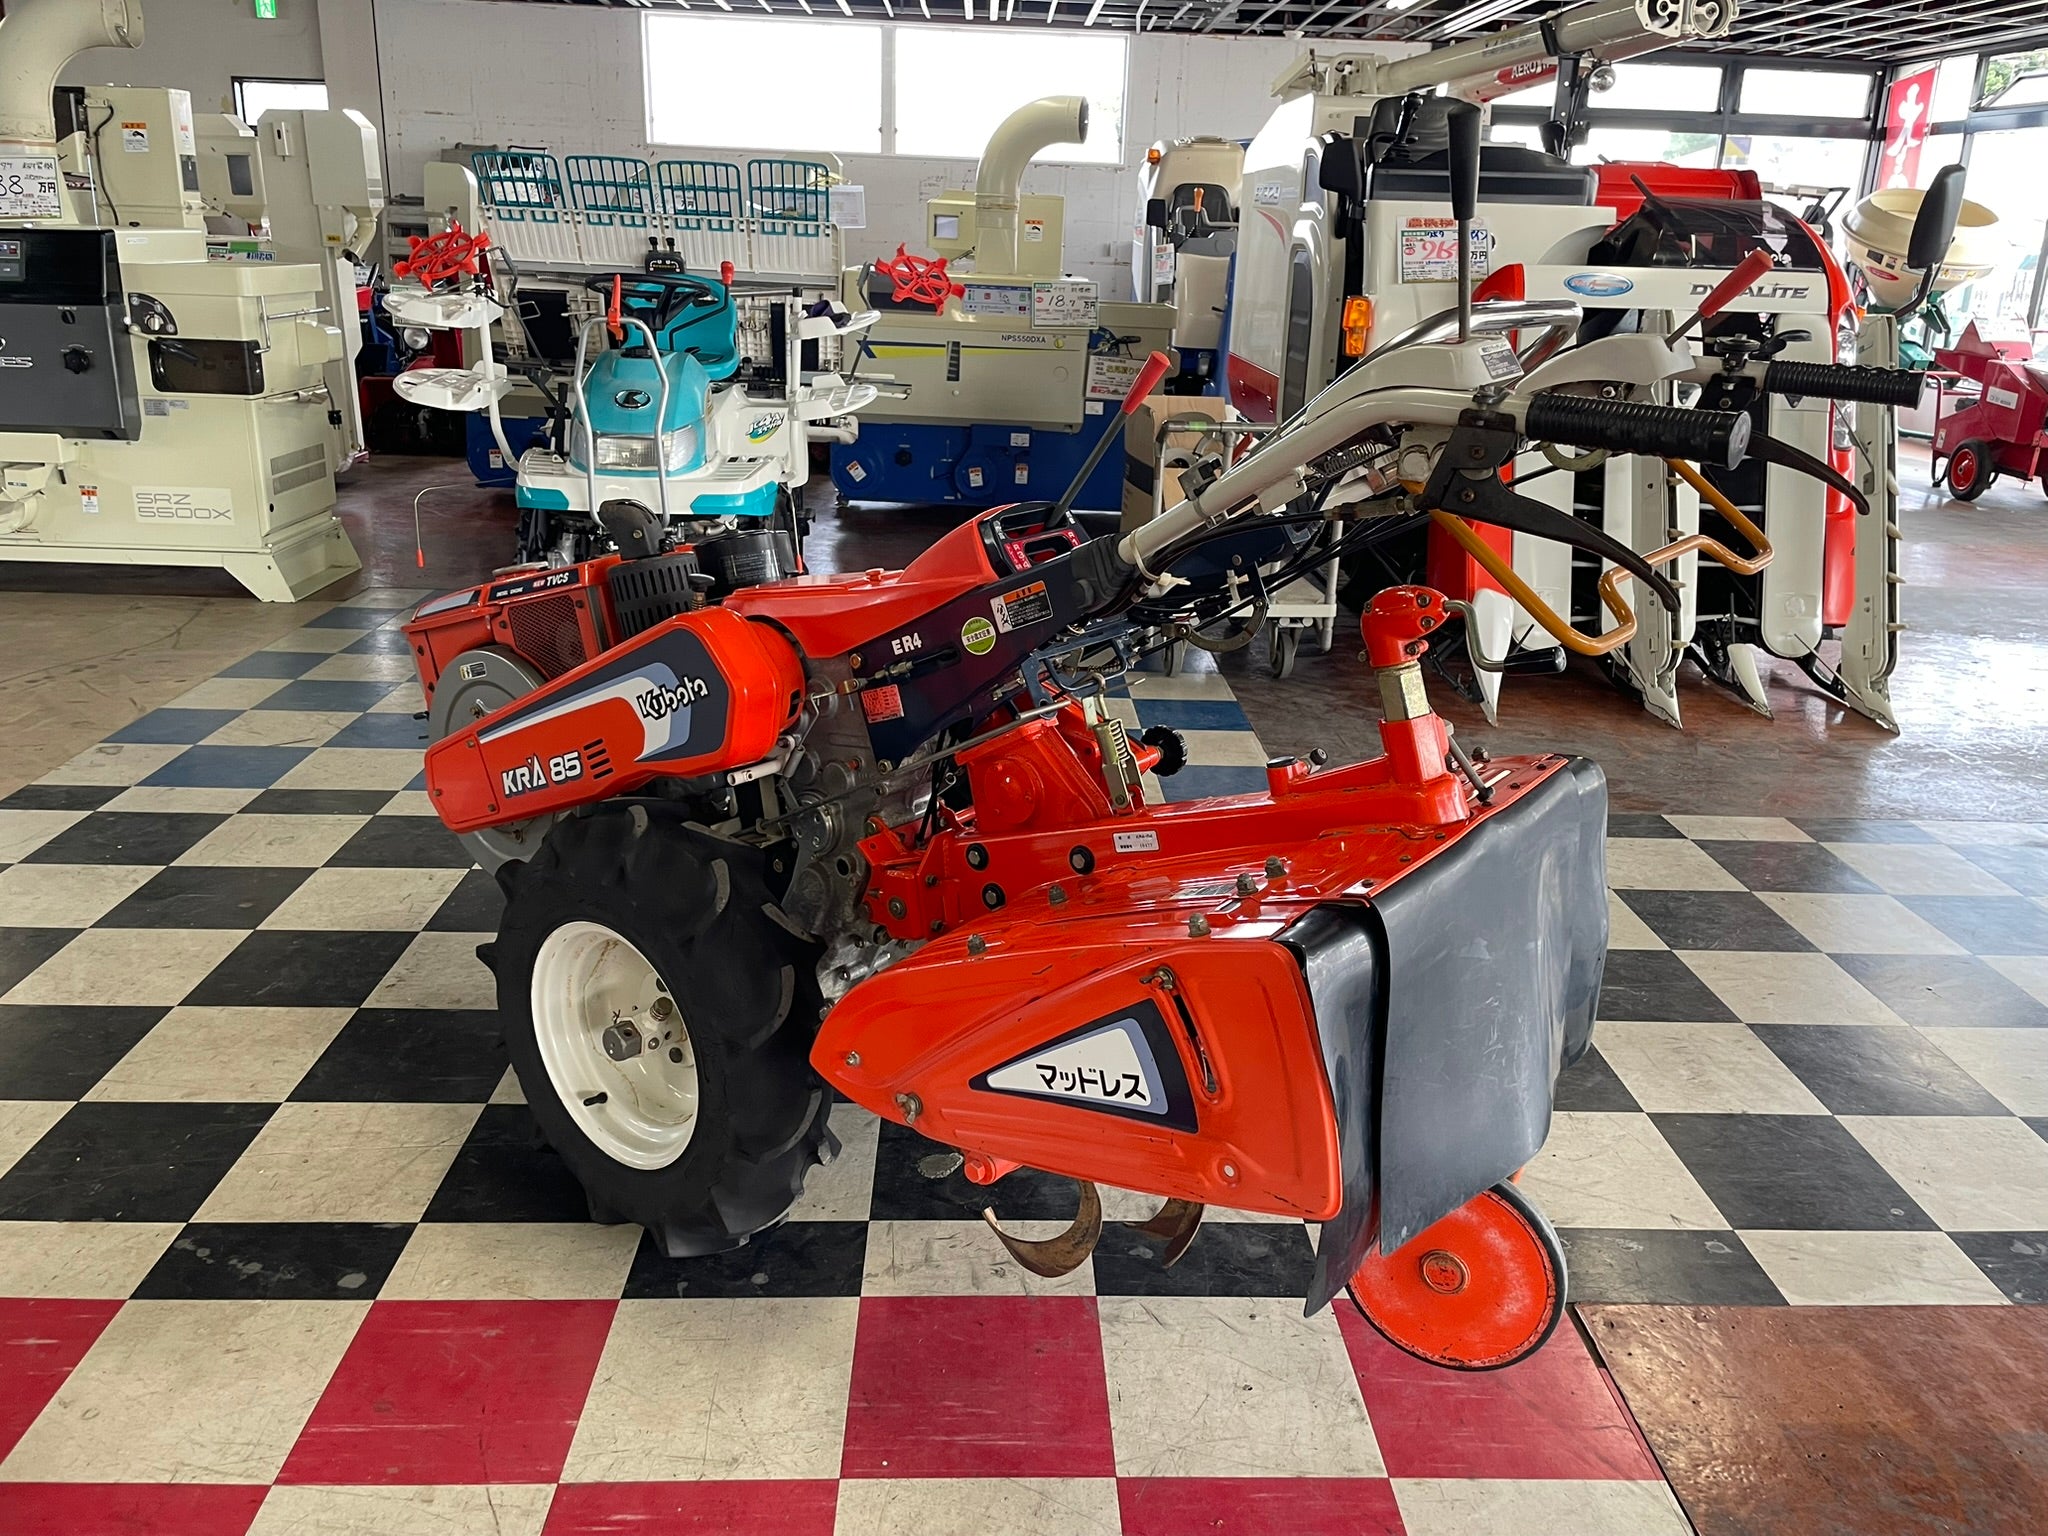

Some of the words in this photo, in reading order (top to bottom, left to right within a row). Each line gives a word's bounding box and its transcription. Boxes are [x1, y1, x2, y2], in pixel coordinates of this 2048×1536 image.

[38, 182, 56, 193] 万円
[1470, 250, 1487, 260] 万円
[1084, 300, 1096, 310] 万円
[1001, 334, 1047, 344] NPS550DXA
[136, 492, 192, 506] SRZ
[138, 506, 232, 520] 5500X
[532, 579, 546, 588] NEW
[546, 572, 570, 586] TVCS
[891, 632, 922, 655] ER4
[637, 675, 709, 720] Kubota
[550, 751, 582, 783] 85
[1035, 1063, 1147, 1101] マッドレス
